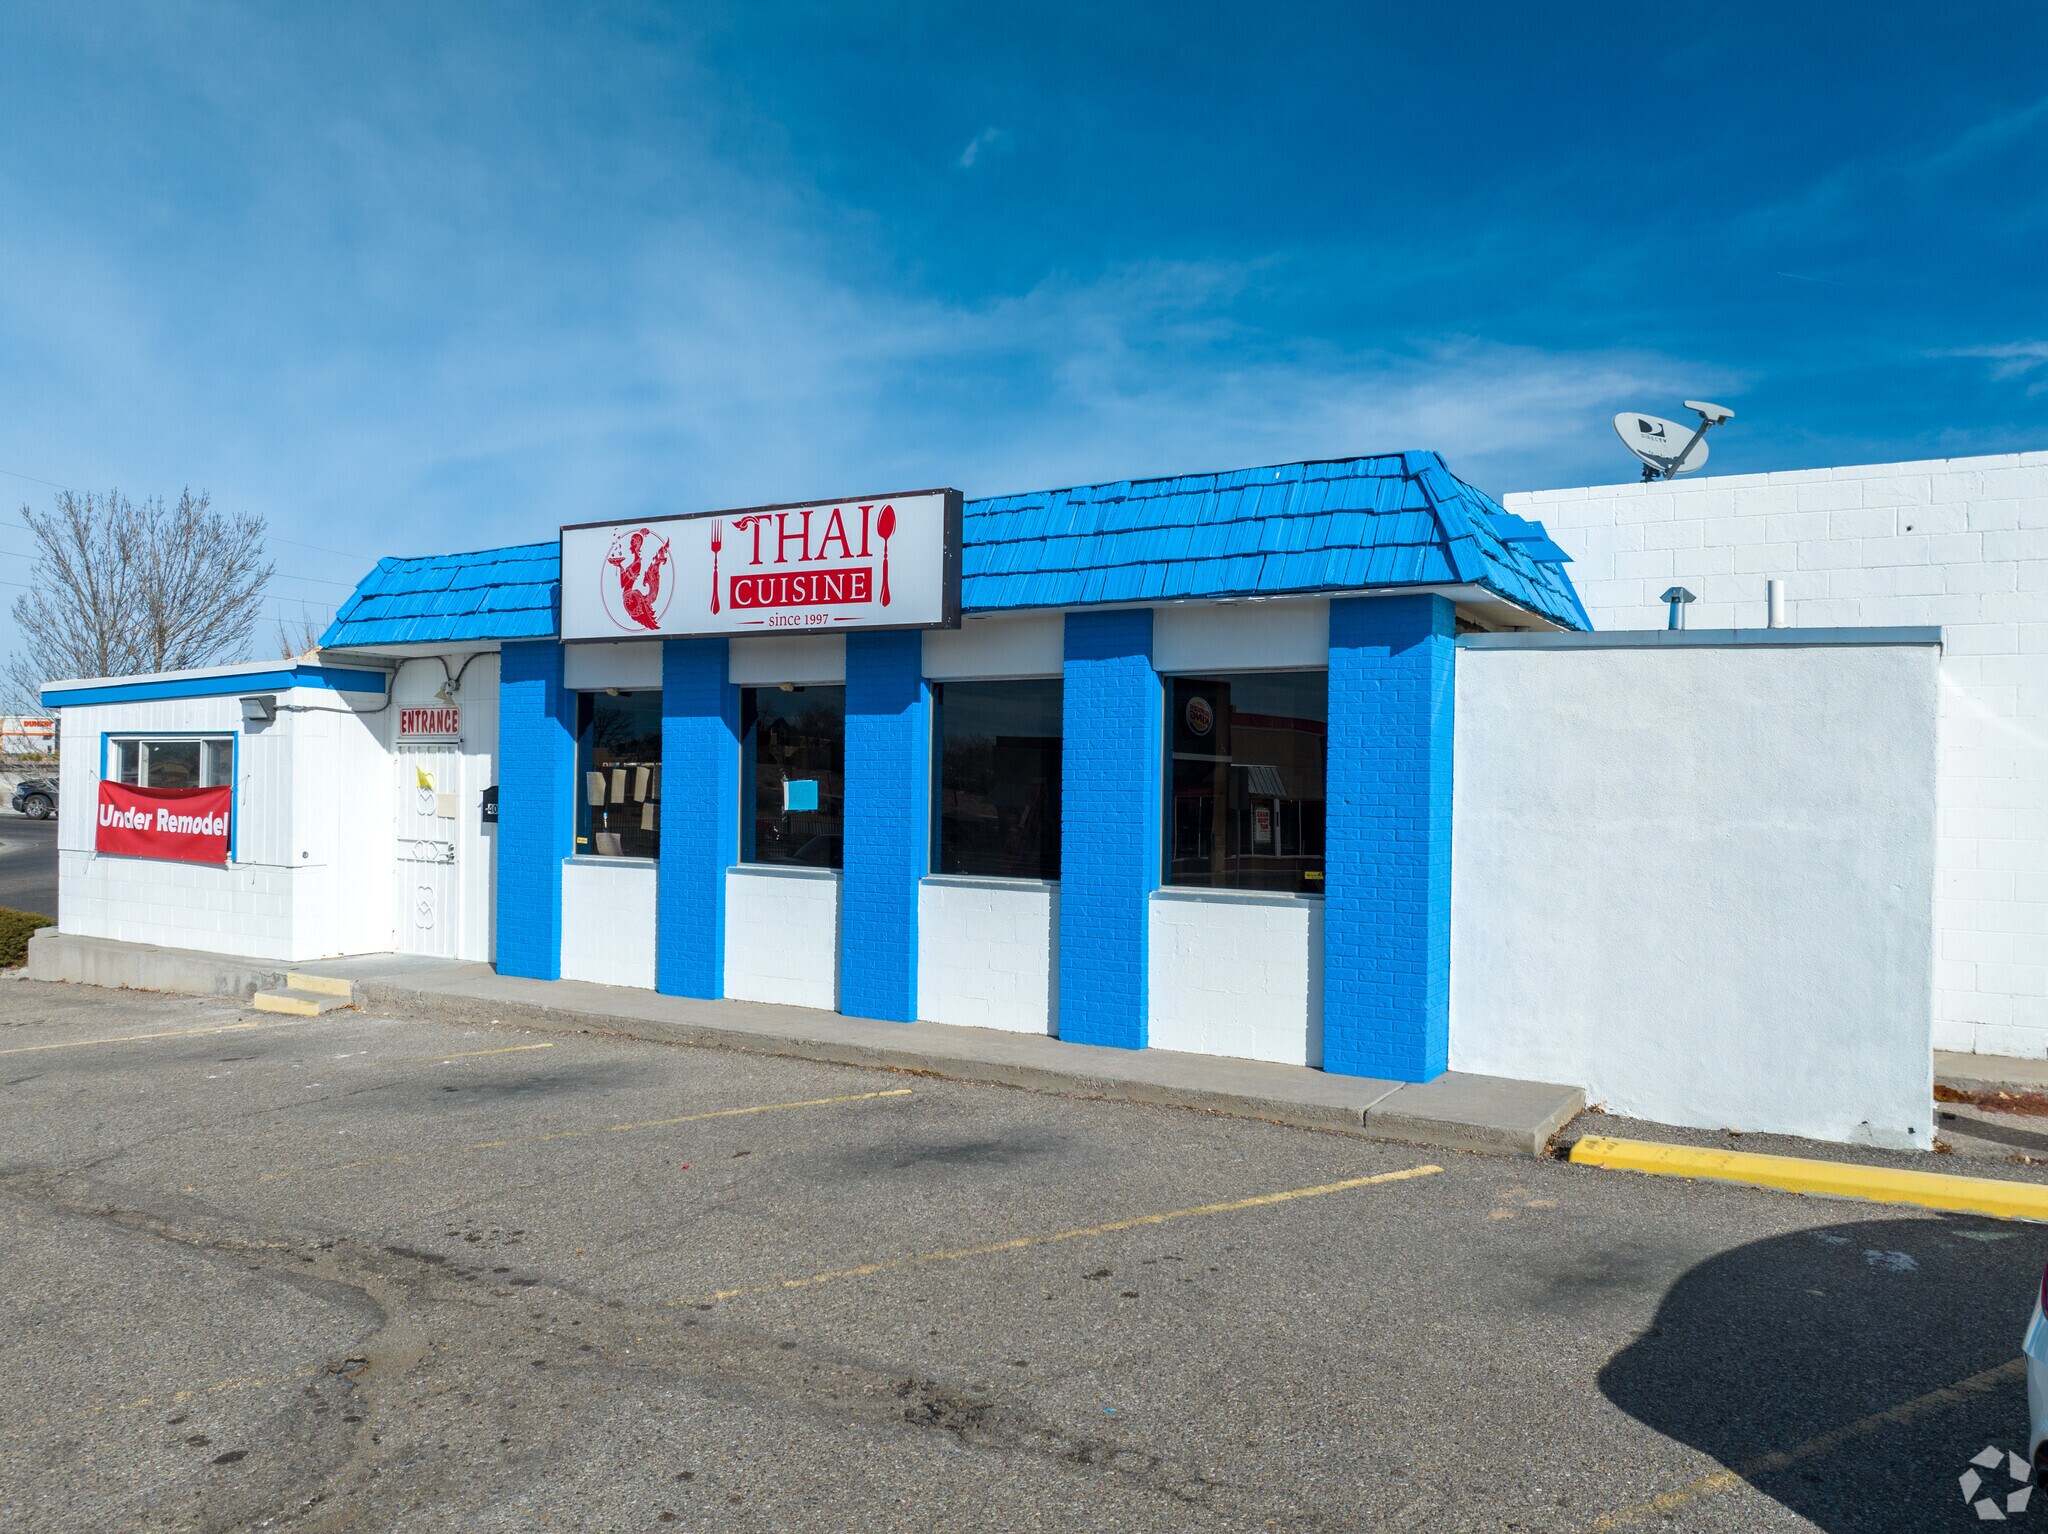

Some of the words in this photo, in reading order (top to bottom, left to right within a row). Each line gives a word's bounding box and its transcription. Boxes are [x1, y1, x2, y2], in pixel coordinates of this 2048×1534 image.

[732, 505, 874, 565] THAI
[735, 572, 867, 606] CUISINE
[768, 612, 801, 627] since
[804, 613, 829, 626] 1997
[401, 709, 458, 734] ENTRANCE
[100, 803, 153, 831] Under
[156, 808, 229, 836] Remodel
